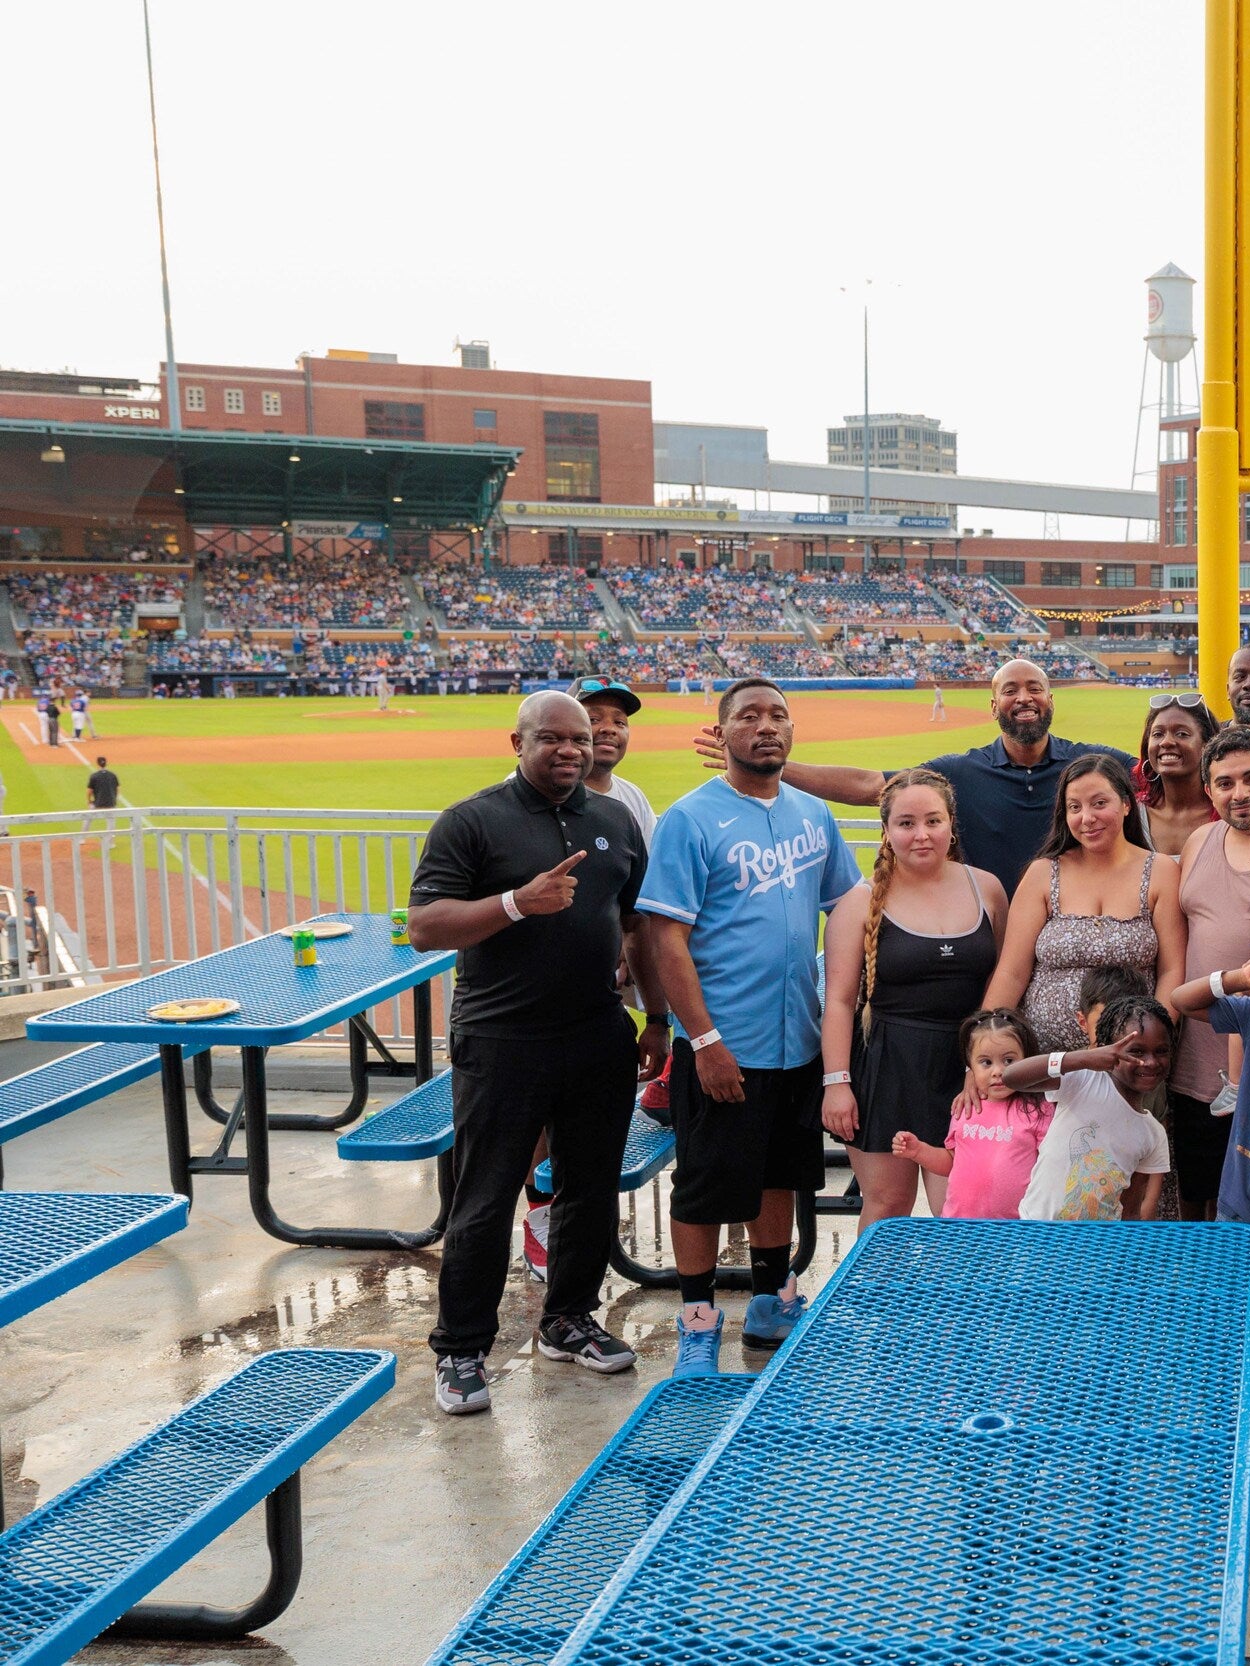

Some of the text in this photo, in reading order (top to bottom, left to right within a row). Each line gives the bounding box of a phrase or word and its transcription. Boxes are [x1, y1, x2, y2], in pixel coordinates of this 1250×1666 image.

[104, 404, 160, 419] XPERI
[604, 507, 655, 518] BREWING
[656, 509, 708, 520] CONCERN
[798, 514, 845, 524] FLIGHT DECK
[903, 517, 948, 528] FLIGHT DECK
[727, 818, 829, 891] Royals
